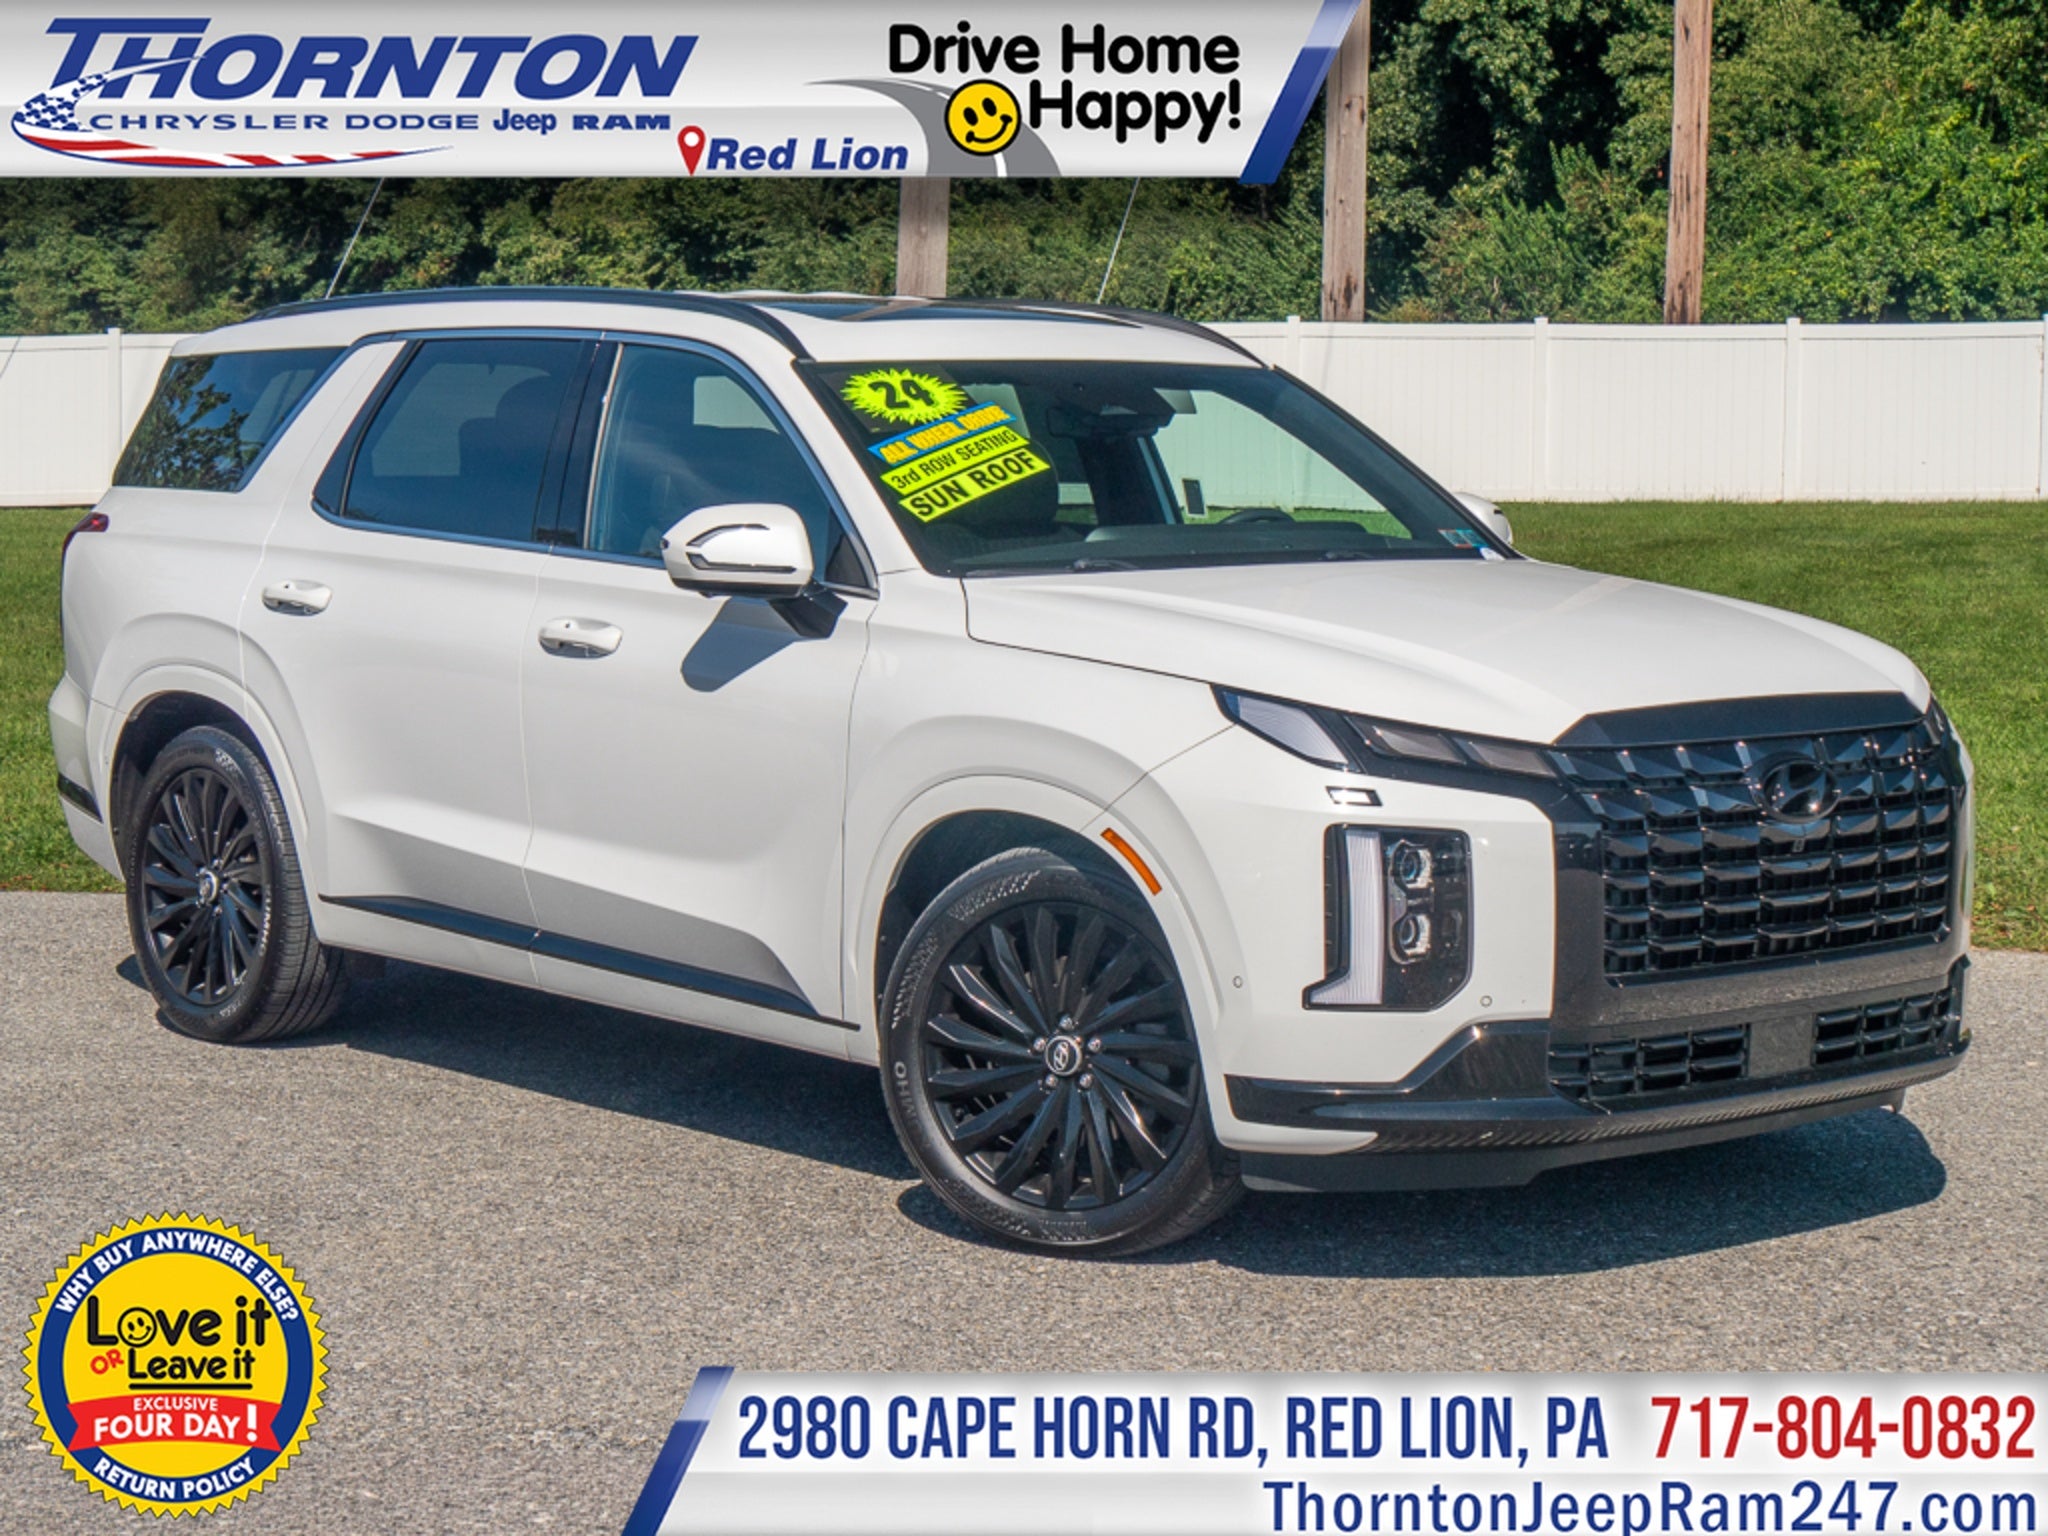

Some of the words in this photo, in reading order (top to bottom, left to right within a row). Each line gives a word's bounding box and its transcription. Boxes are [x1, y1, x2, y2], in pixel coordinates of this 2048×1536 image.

[868, 379, 935, 410] 24
[890, 467, 922, 490] 3rd
[918, 452, 957, 479] ROW
[954, 429, 1018, 463] SEATING
[909, 479, 969, 517] SUN
[968, 450, 1037, 490] ROOF
